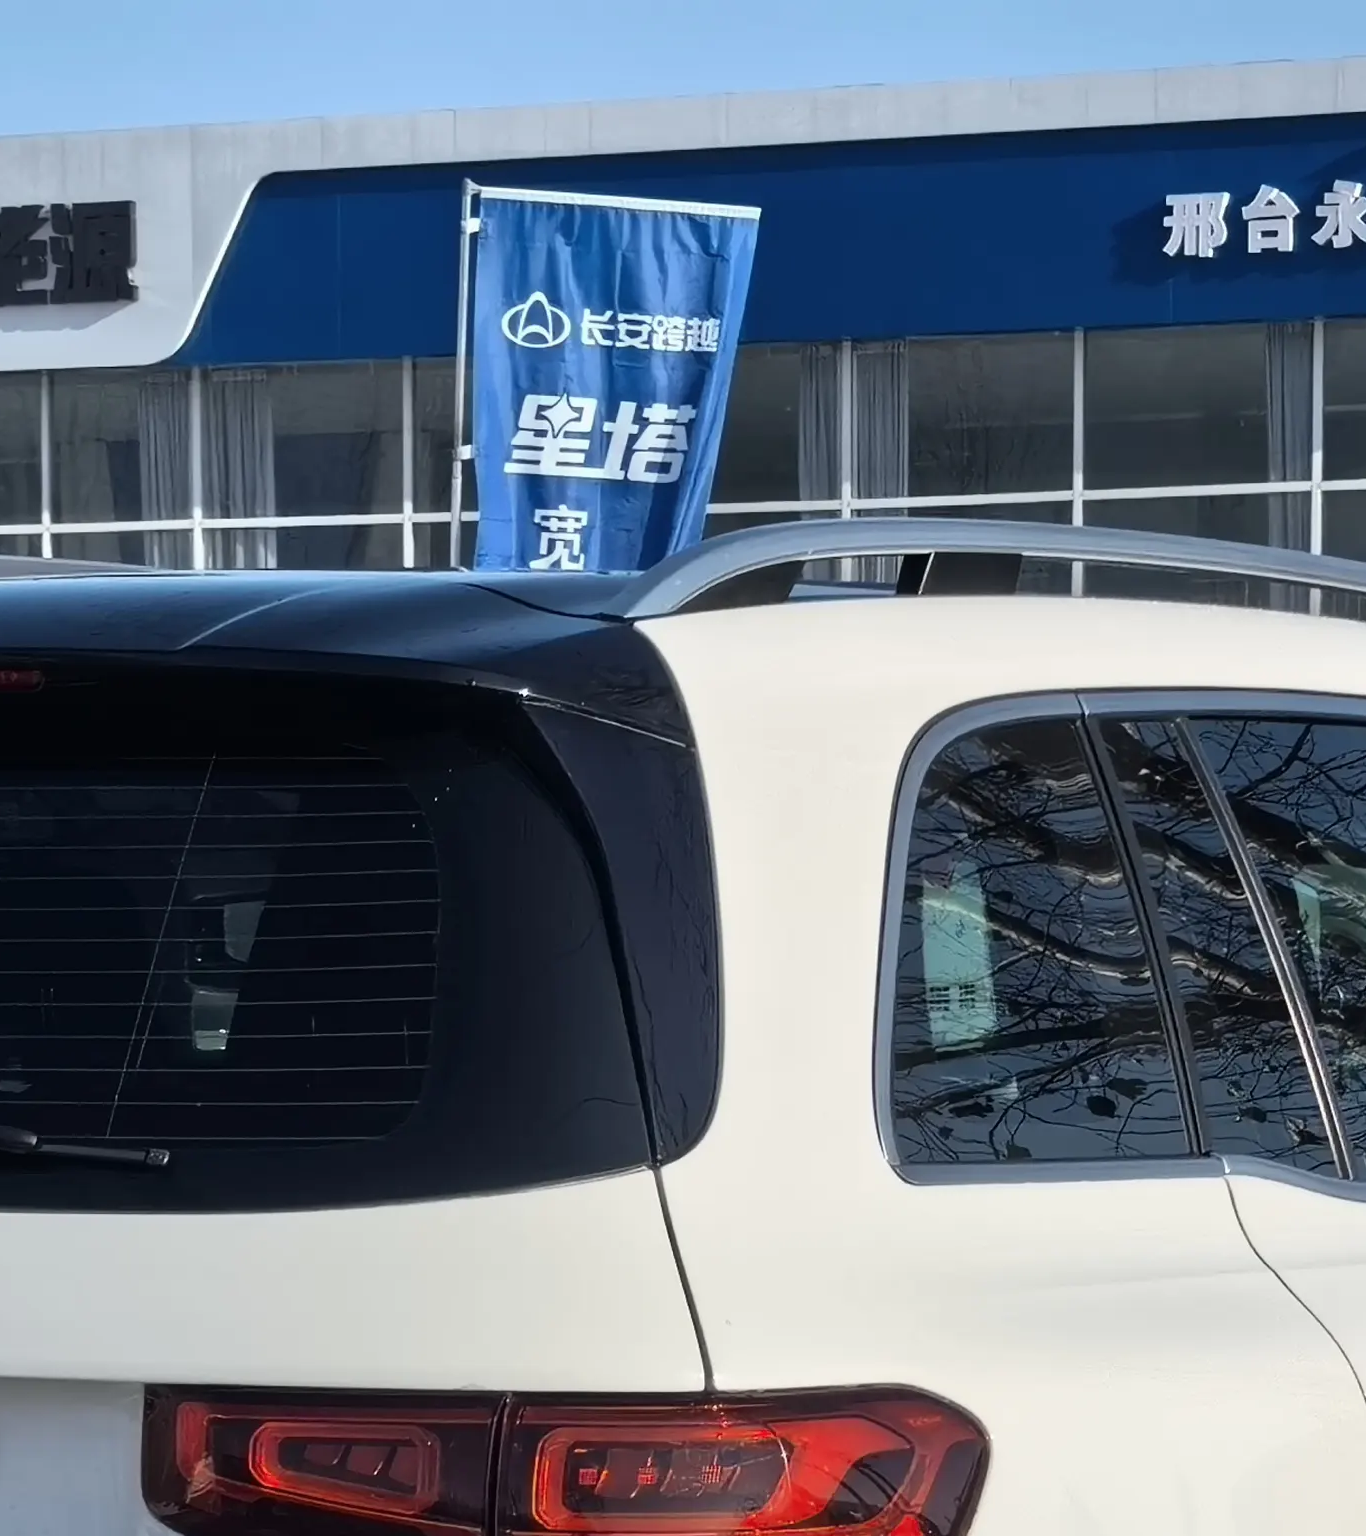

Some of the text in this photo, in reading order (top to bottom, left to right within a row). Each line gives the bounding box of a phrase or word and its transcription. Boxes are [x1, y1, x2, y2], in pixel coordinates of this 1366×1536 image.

[580, 307, 721, 353] 长安跨越
[503, 393, 698, 484] 星塔
[529, 504, 588, 570] 宽
